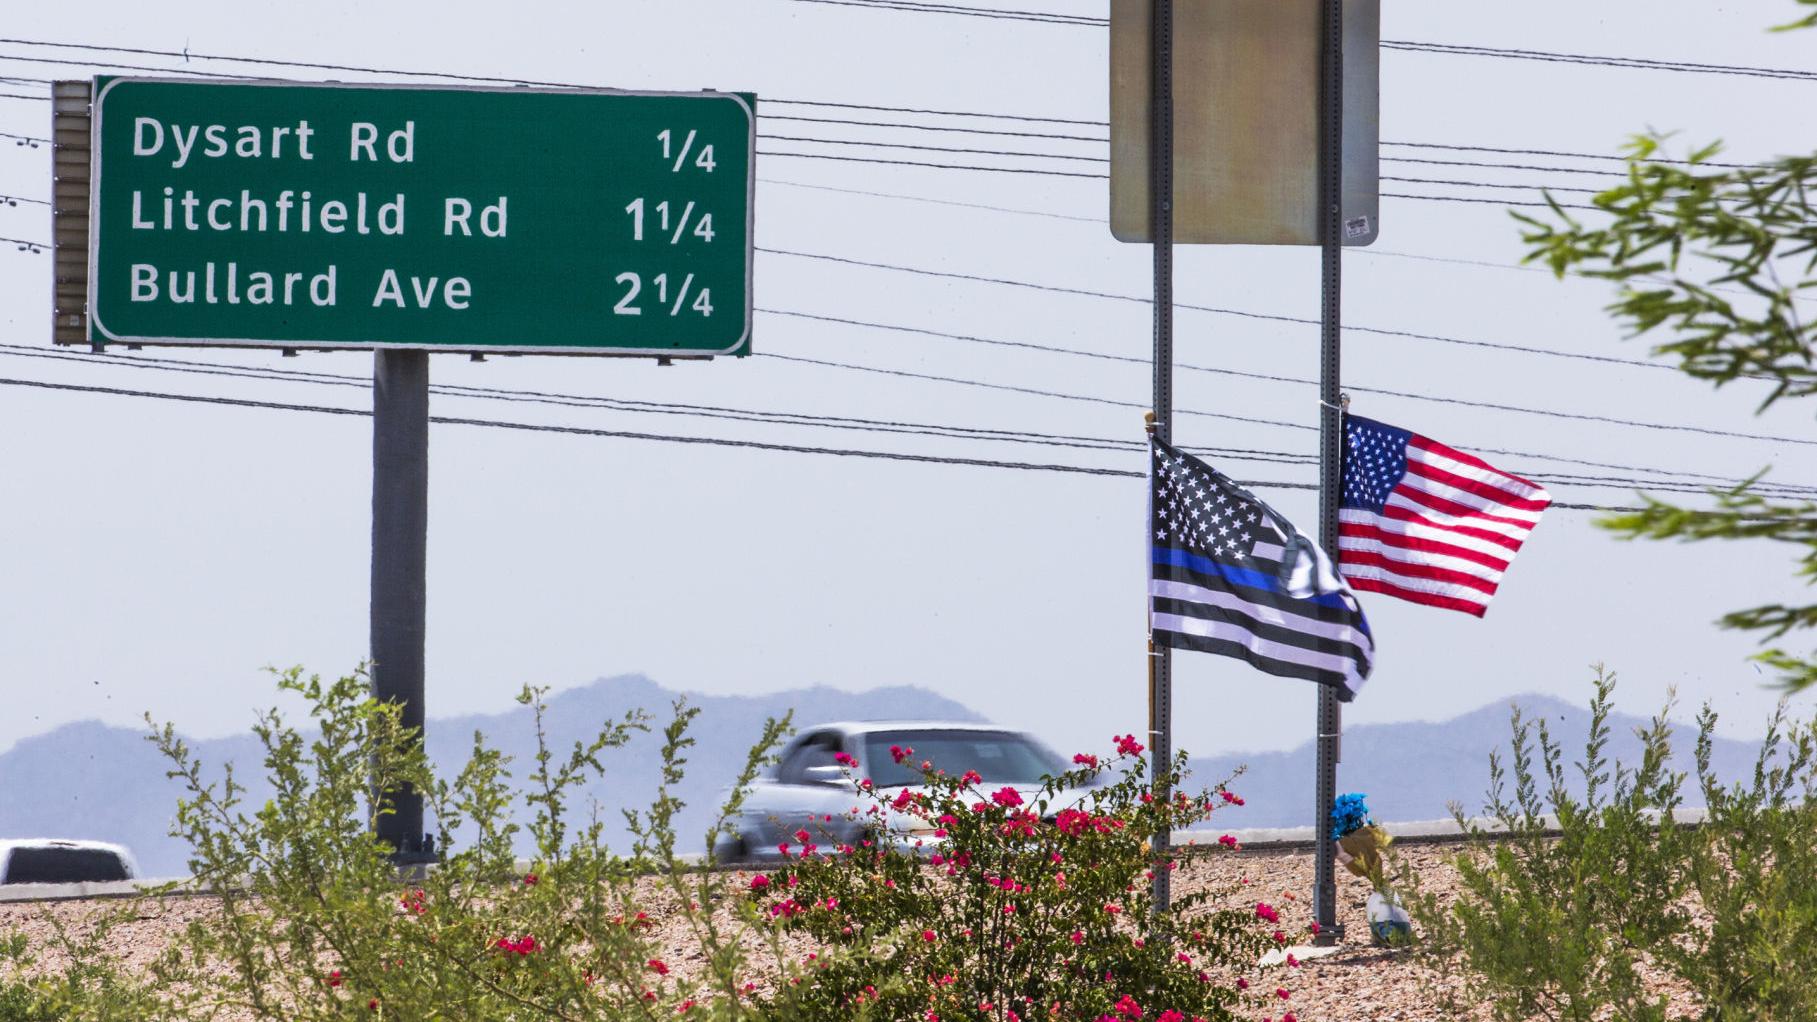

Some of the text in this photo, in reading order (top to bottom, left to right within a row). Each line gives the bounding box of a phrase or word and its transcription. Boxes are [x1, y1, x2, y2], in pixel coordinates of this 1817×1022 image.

[133, 116, 314, 168] Dysart
[349, 121, 414, 163] Rd
[131, 188, 405, 236] Litchfield
[443, 195, 507, 238] Rd
[130, 261, 336, 307] Bullard
[371, 268, 471, 309] Ave
